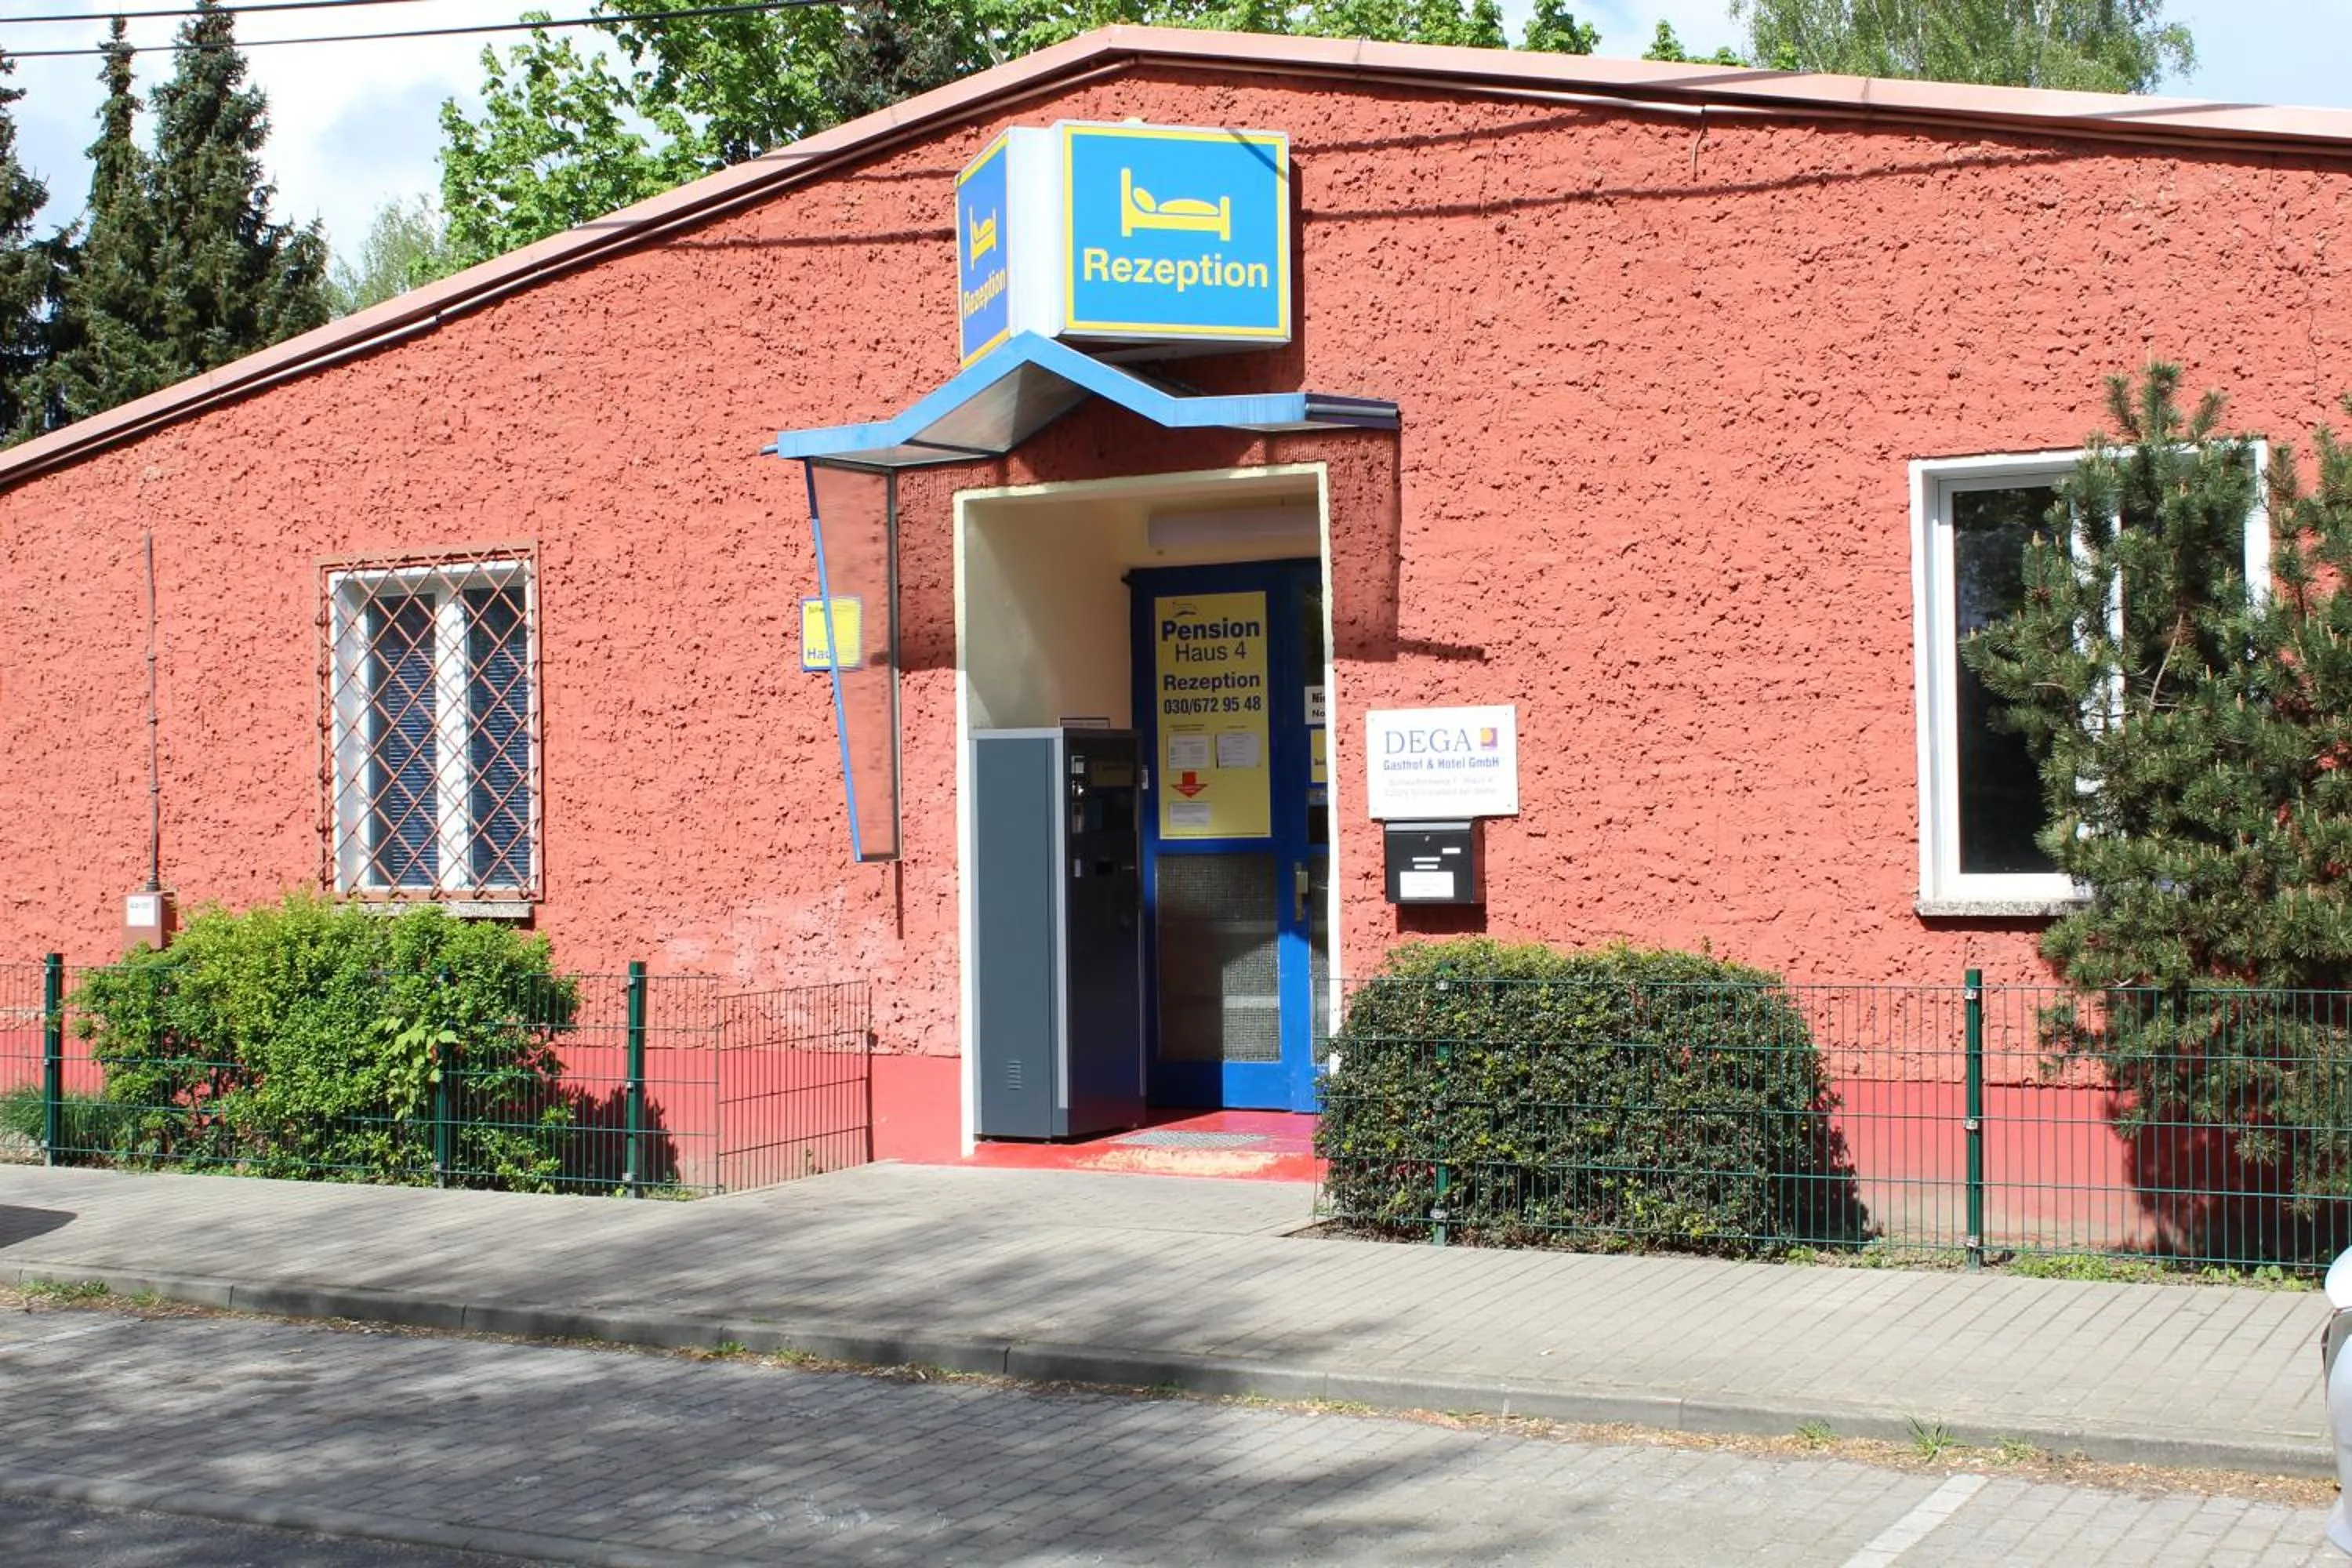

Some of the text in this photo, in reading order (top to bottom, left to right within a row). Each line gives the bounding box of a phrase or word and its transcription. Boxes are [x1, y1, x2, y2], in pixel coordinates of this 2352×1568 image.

[1083, 247, 1269, 292] Rezeption
[964, 269, 1006, 319] Rezeption
[1162, 617, 1261, 642] Pension
[1176, 641, 1247, 662] Haus 4
[1163, 671, 1261, 693] Rezeption
[1163, 695, 1261, 716] 030/672 95 48
[1385, 728, 1472, 754] DEGA
[1383, 756, 1500, 771] Gasthof & Hotel GmbH
